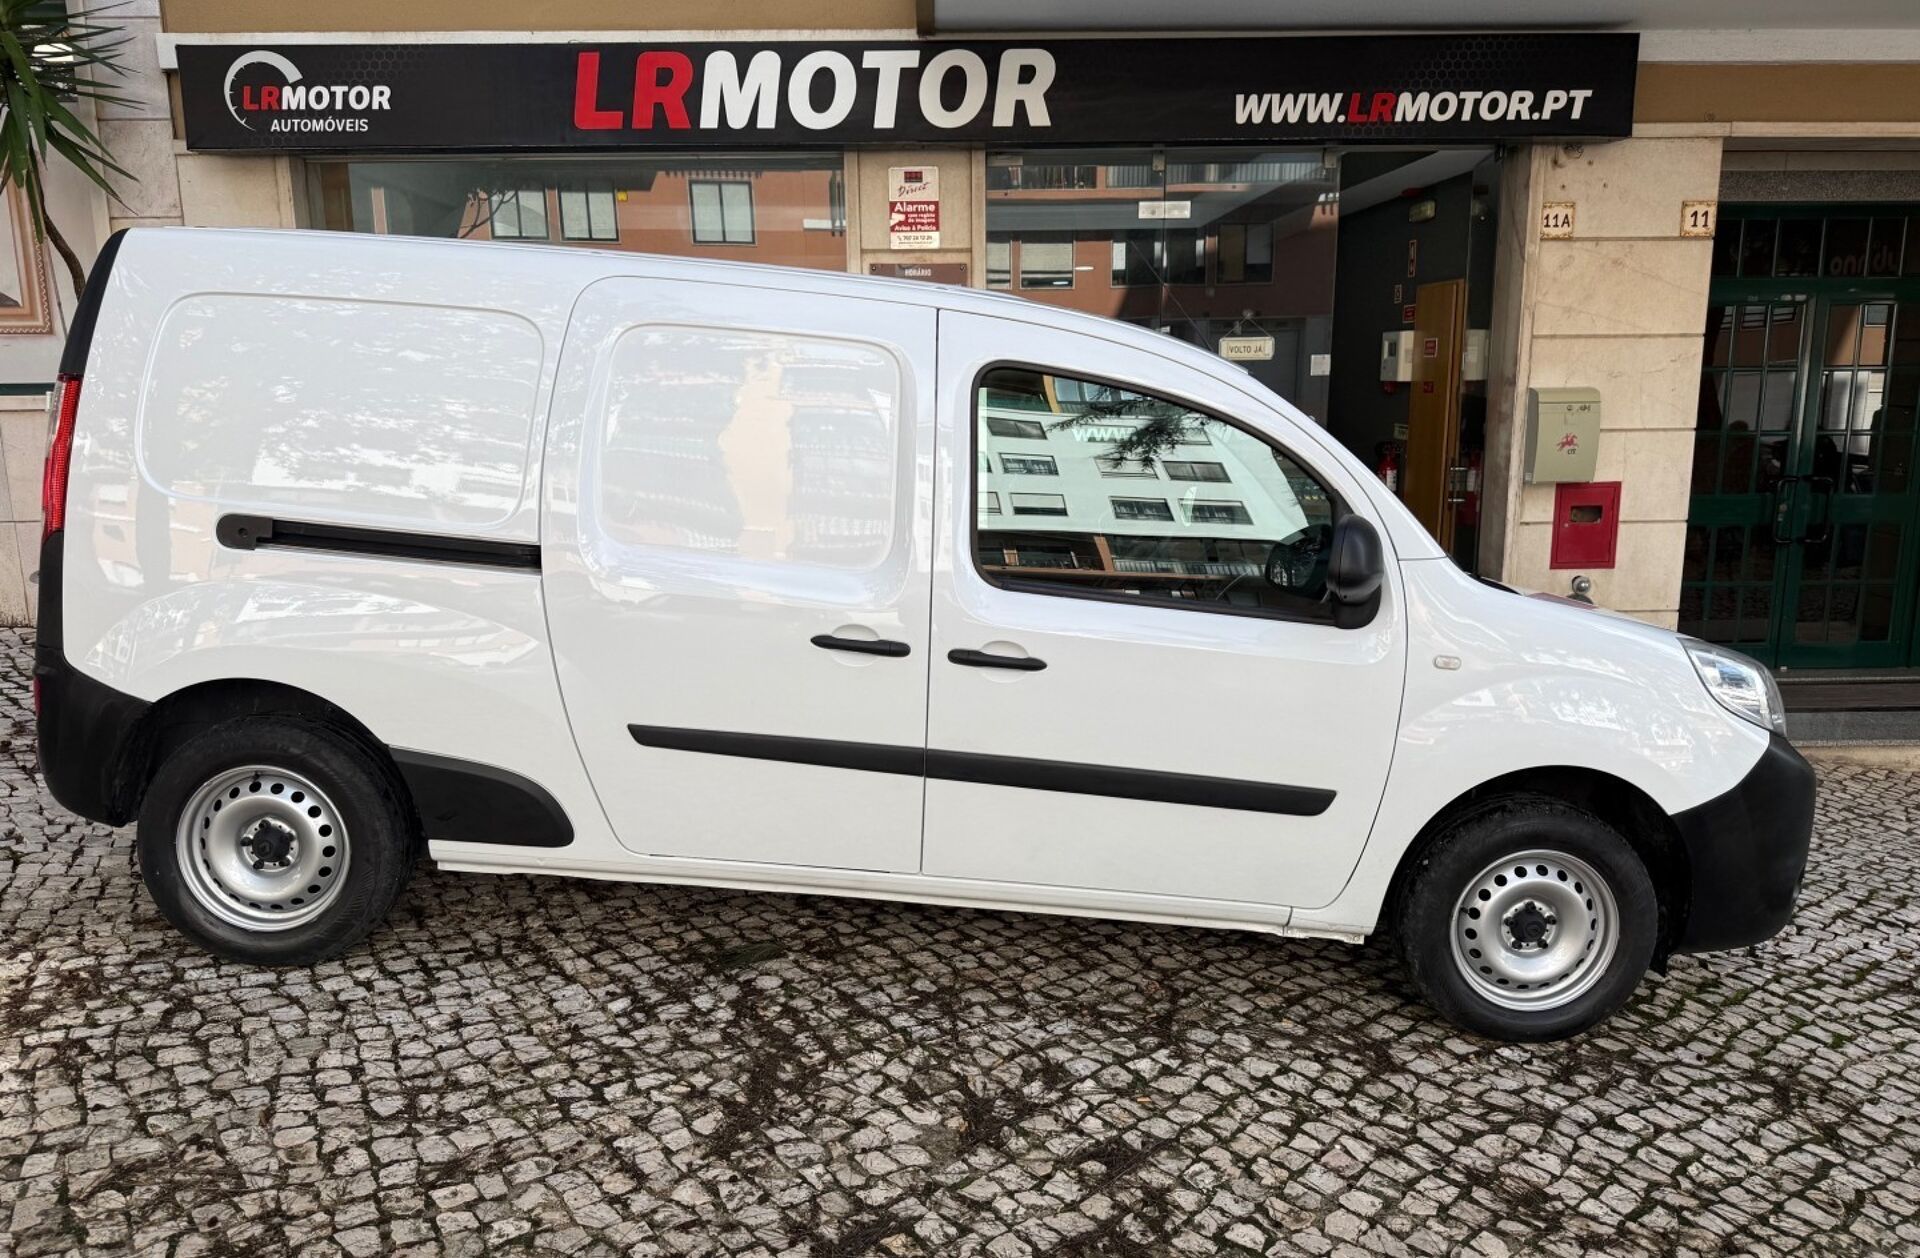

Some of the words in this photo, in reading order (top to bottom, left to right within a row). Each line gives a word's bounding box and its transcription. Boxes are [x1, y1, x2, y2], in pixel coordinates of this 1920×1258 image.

[243, 85, 392, 110] LRMOTOR
[574, 48, 1056, 130] LRMOTOR
[1235, 89, 1594, 125] WWW.LRMOTOR.PT
[270, 115, 370, 132] AUTOMÓVEIS
[894, 202, 936, 212] Alarme
[1543, 213, 1571, 228] 11A
[1690, 210, 1710, 228] 11
[1228, 345, 1252, 354] VOLTO
